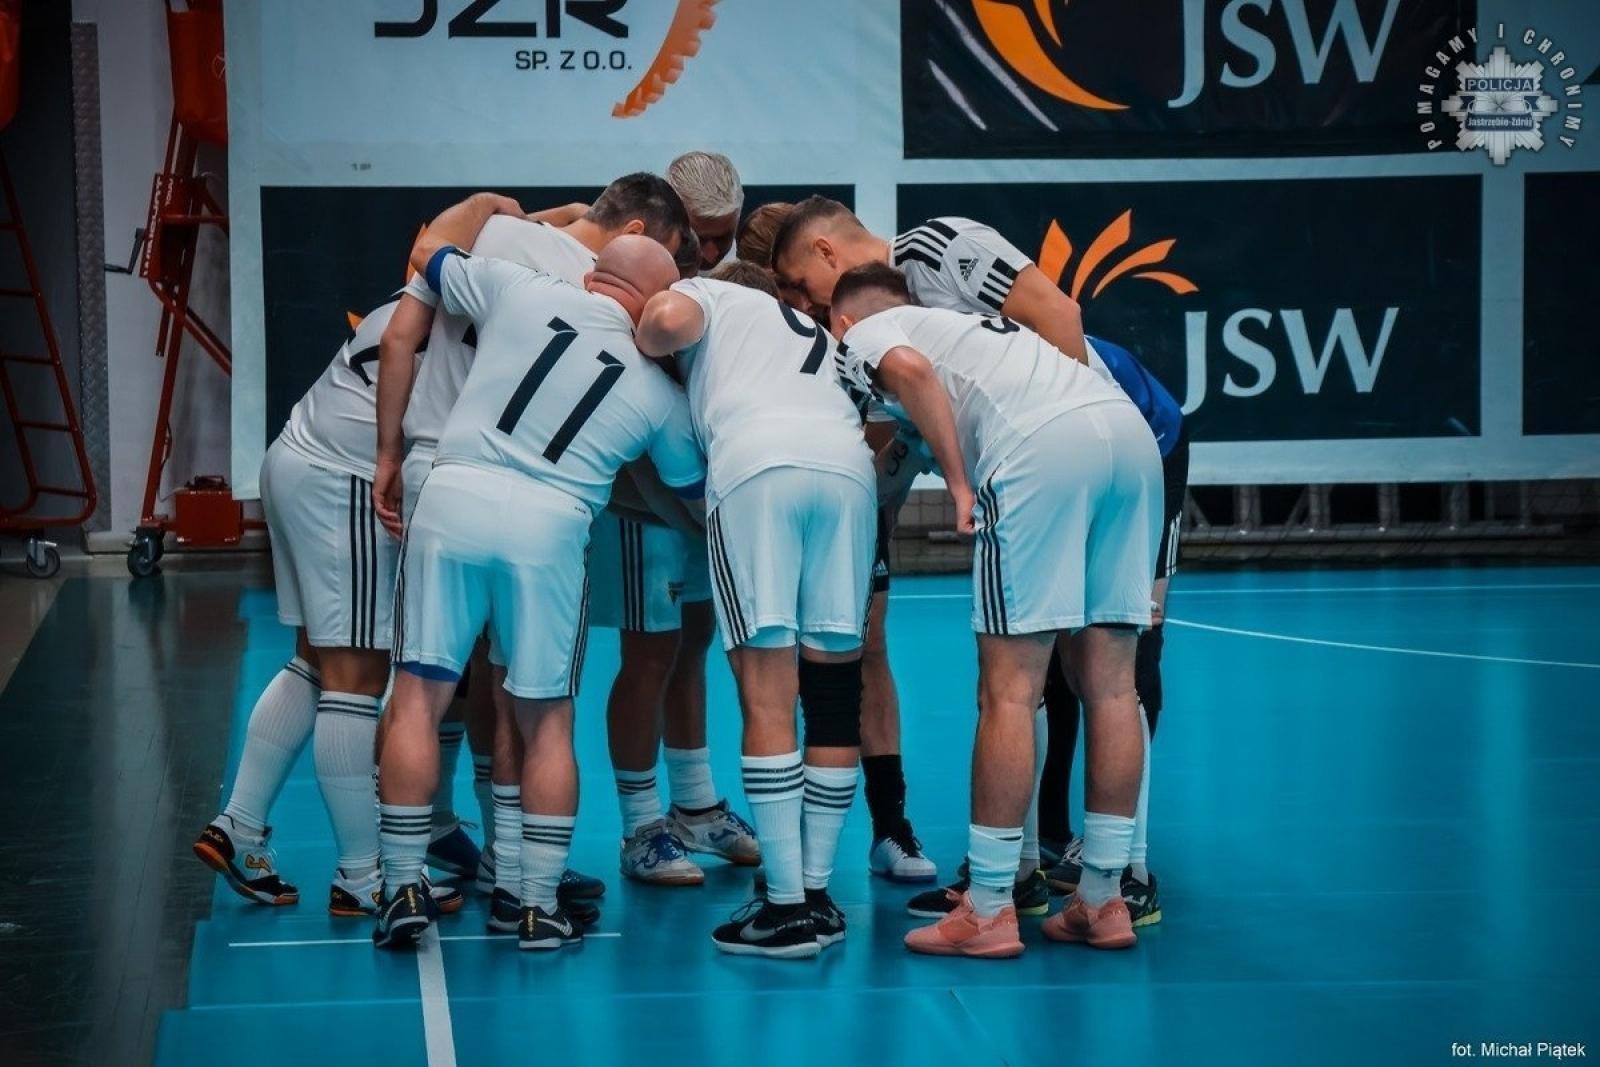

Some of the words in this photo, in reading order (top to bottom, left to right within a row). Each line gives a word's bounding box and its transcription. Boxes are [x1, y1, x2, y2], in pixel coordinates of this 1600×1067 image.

[515, 51, 549, 70] SP.
[560, 51, 575, 70] Z
[1168, 0, 1402, 109] JSW
[496, 316, 625, 464] 11
[1180, 306, 1400, 416] JSW
